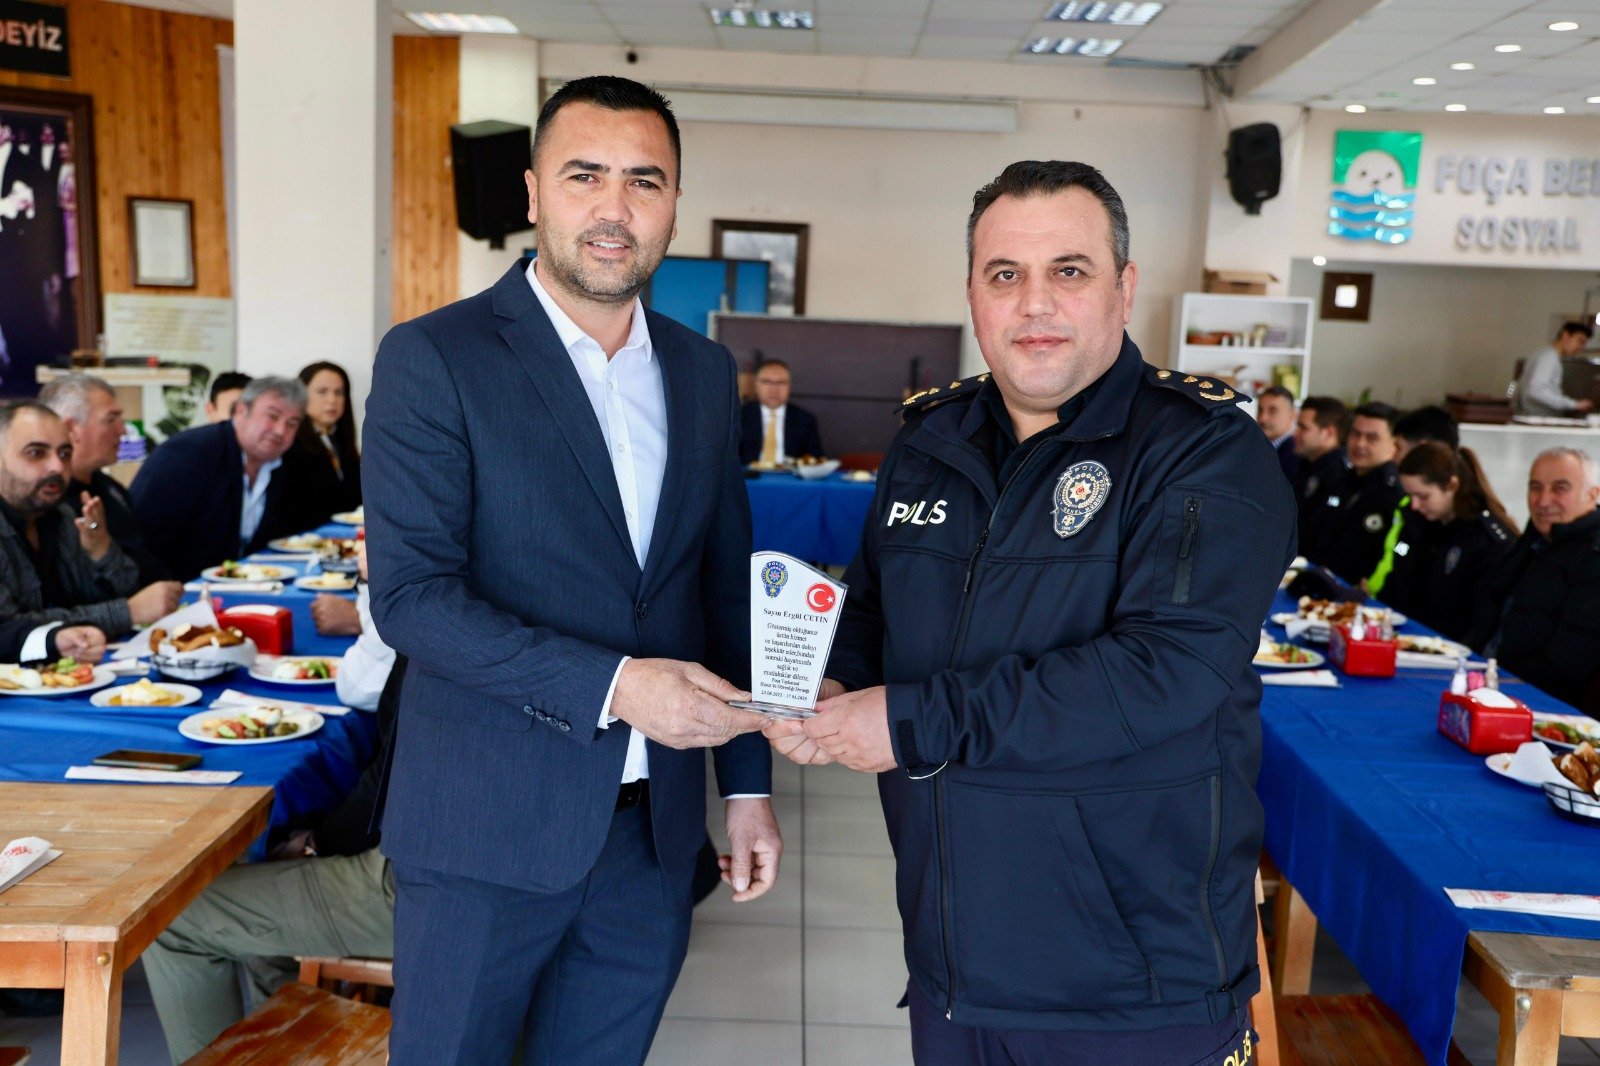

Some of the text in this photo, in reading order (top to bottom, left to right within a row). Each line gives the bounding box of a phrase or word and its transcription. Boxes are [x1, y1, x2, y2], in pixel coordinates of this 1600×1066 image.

[0, 18, 63, 52] EYİZ
[1434, 155, 1531, 206] FOÇA
[1455, 215, 1582, 253] SOSYAL
[763, 608, 829, 623] Sayın Ergül ÇETİN
